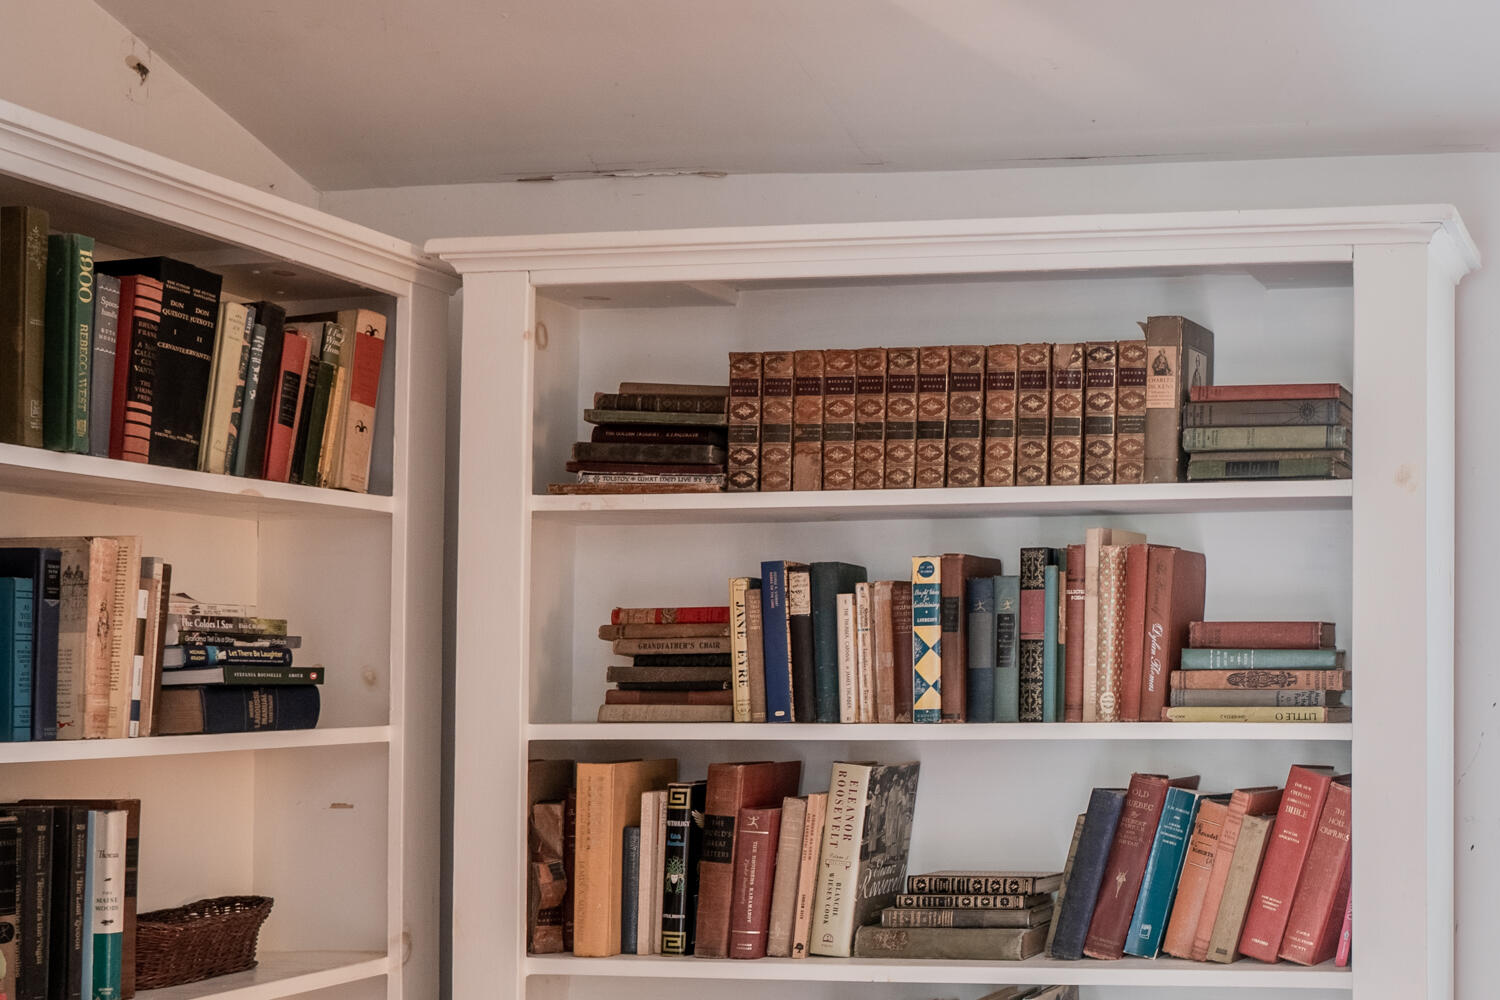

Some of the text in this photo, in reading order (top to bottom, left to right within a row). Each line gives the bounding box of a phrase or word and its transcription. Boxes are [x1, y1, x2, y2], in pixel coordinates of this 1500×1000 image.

[79, 249, 94, 303] 1900
[169, 299, 185, 309] DON
[194, 307, 210, 317] DON
[161, 307, 190, 321] QUIXOTE
[77, 324, 88, 412] REBECCA WEST
[182, 616, 194, 628] The
[194, 618, 216, 629] Colors
[223, 620, 235, 630] Saw
[638, 641, 720, 650] GRANDFATHER'S CHAIR
[736, 601, 749, 689] JANE EYRE
[238, 650, 253, 658] There
[261, 651, 284, 660] Laughter
[1148, 623, 1163, 692] Dylan Thomas
[1275, 711, 1318, 721] LITTLE O
[1132, 789, 1150, 799] OLD
[828, 769, 848, 850] ROOSEVELT
[843, 779, 860, 842] ELEANOR
[1283, 804, 1308, 820] BIBLE
[1327, 816, 1345, 828] HOLY
[747, 888, 755, 924] KARAMAZOV
[823, 872, 835, 926] WIESEN COOK
[832, 881, 842, 918] BLANCHE
